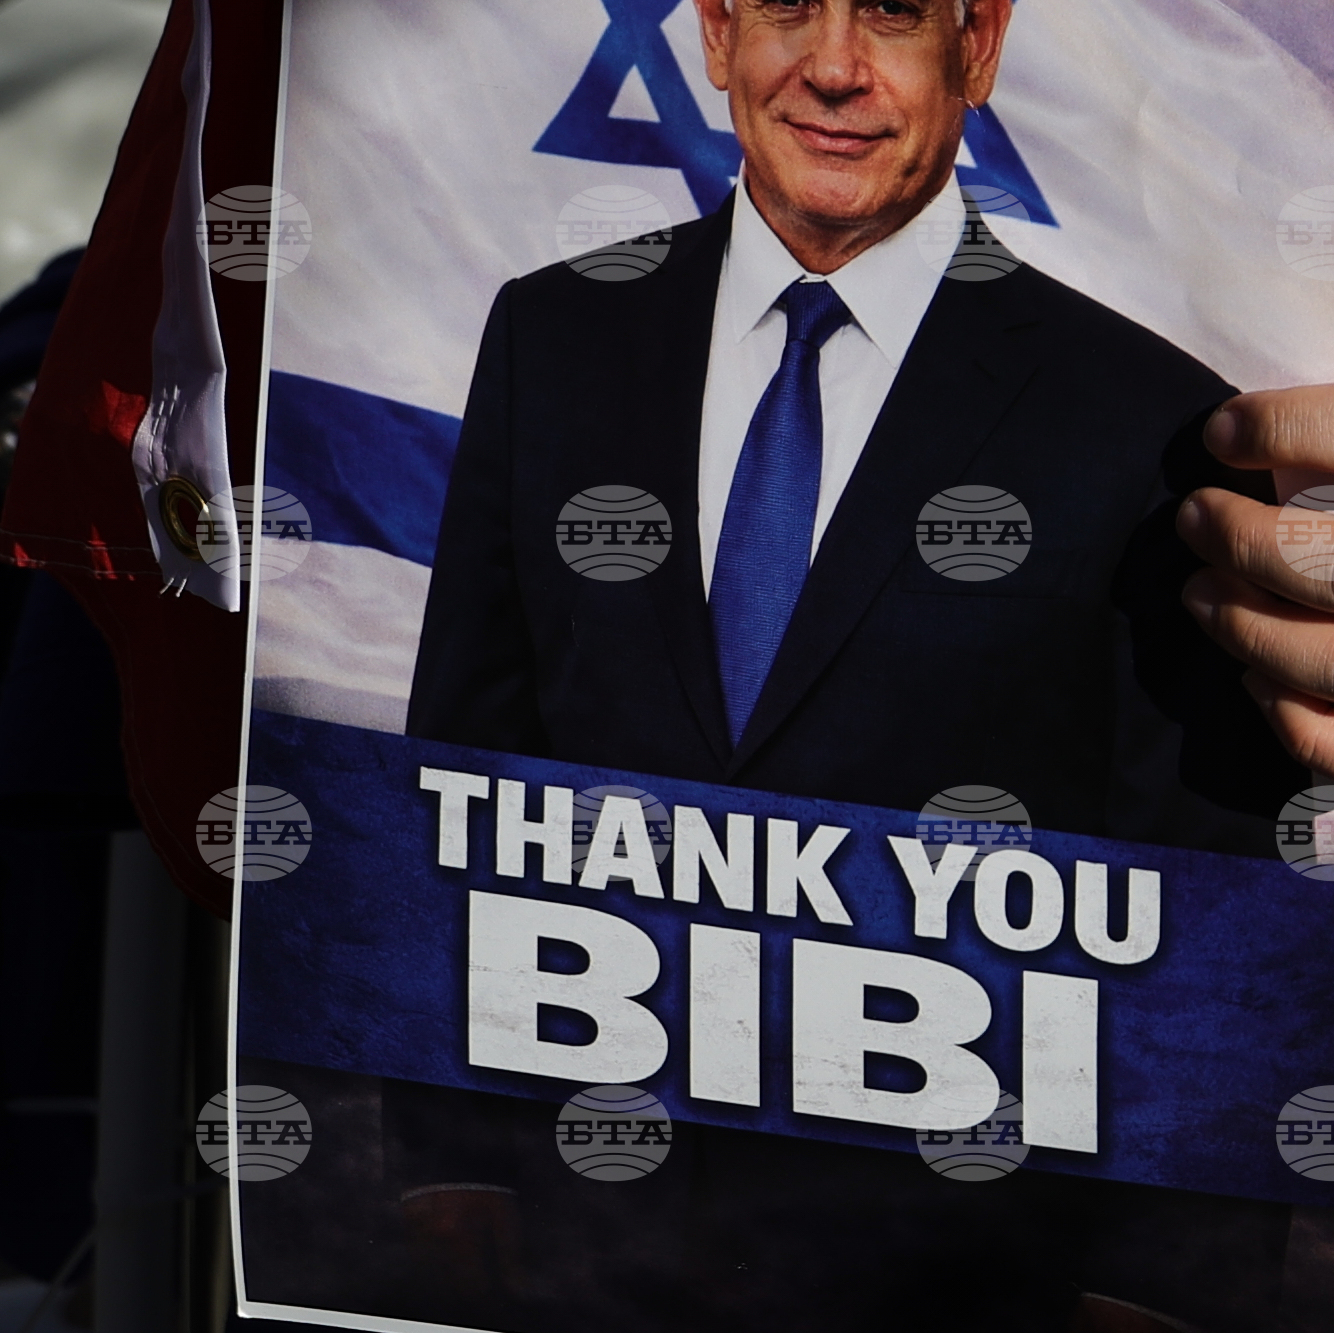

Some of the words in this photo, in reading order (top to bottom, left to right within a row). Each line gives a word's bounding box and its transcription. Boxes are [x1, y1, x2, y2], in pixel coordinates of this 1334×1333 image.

[419, 766, 853, 926] THANK
[887, 835, 1161, 965] YOU
[469, 890, 1098, 1153] BIBI
